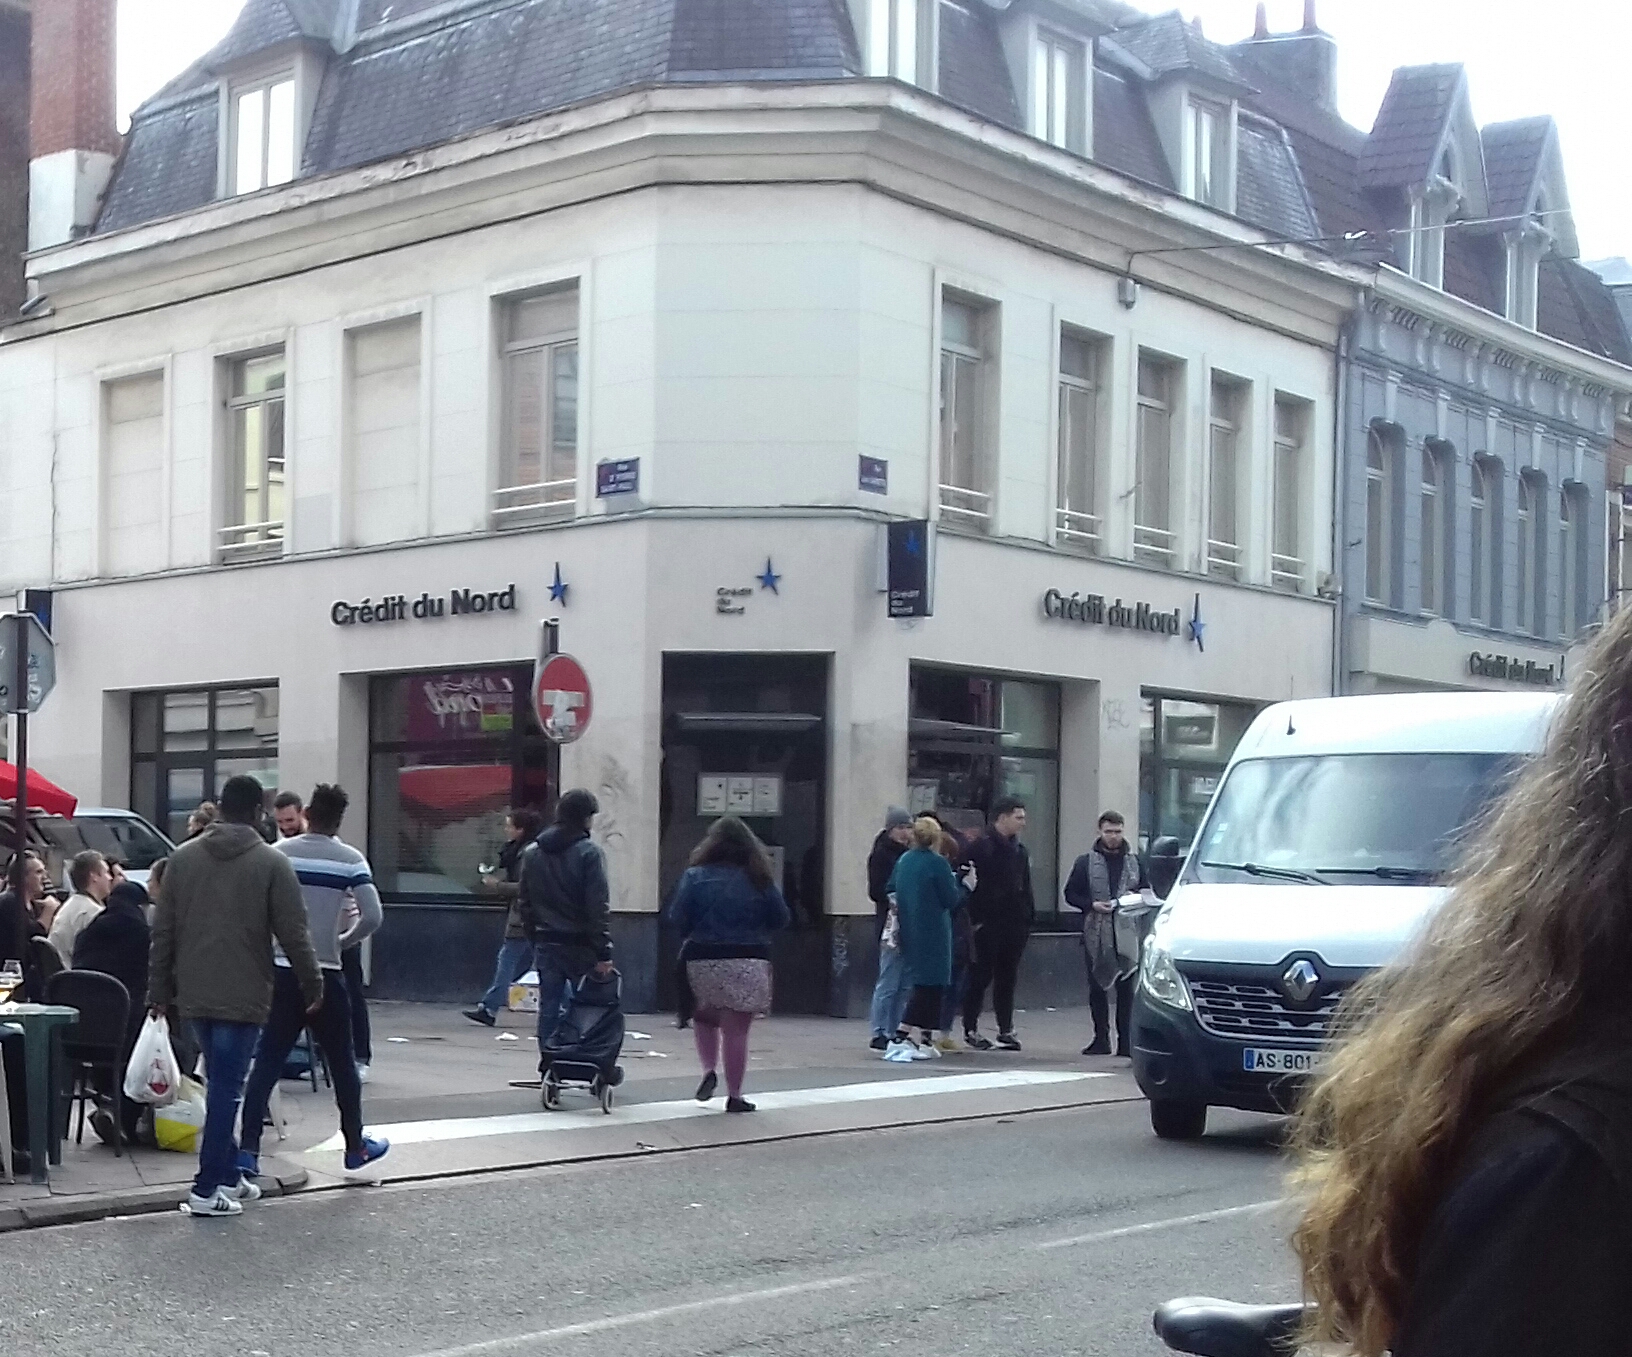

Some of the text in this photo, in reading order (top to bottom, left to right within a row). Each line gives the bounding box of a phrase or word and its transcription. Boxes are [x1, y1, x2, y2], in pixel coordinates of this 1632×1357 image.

[331, 583, 516, 626] Crédit du Nord
[717, 605, 745, 615] Nord
[1045, 588, 1180, 635] Crédit du Nord
[1255, 1052, 1319, 1070] AS-801-
